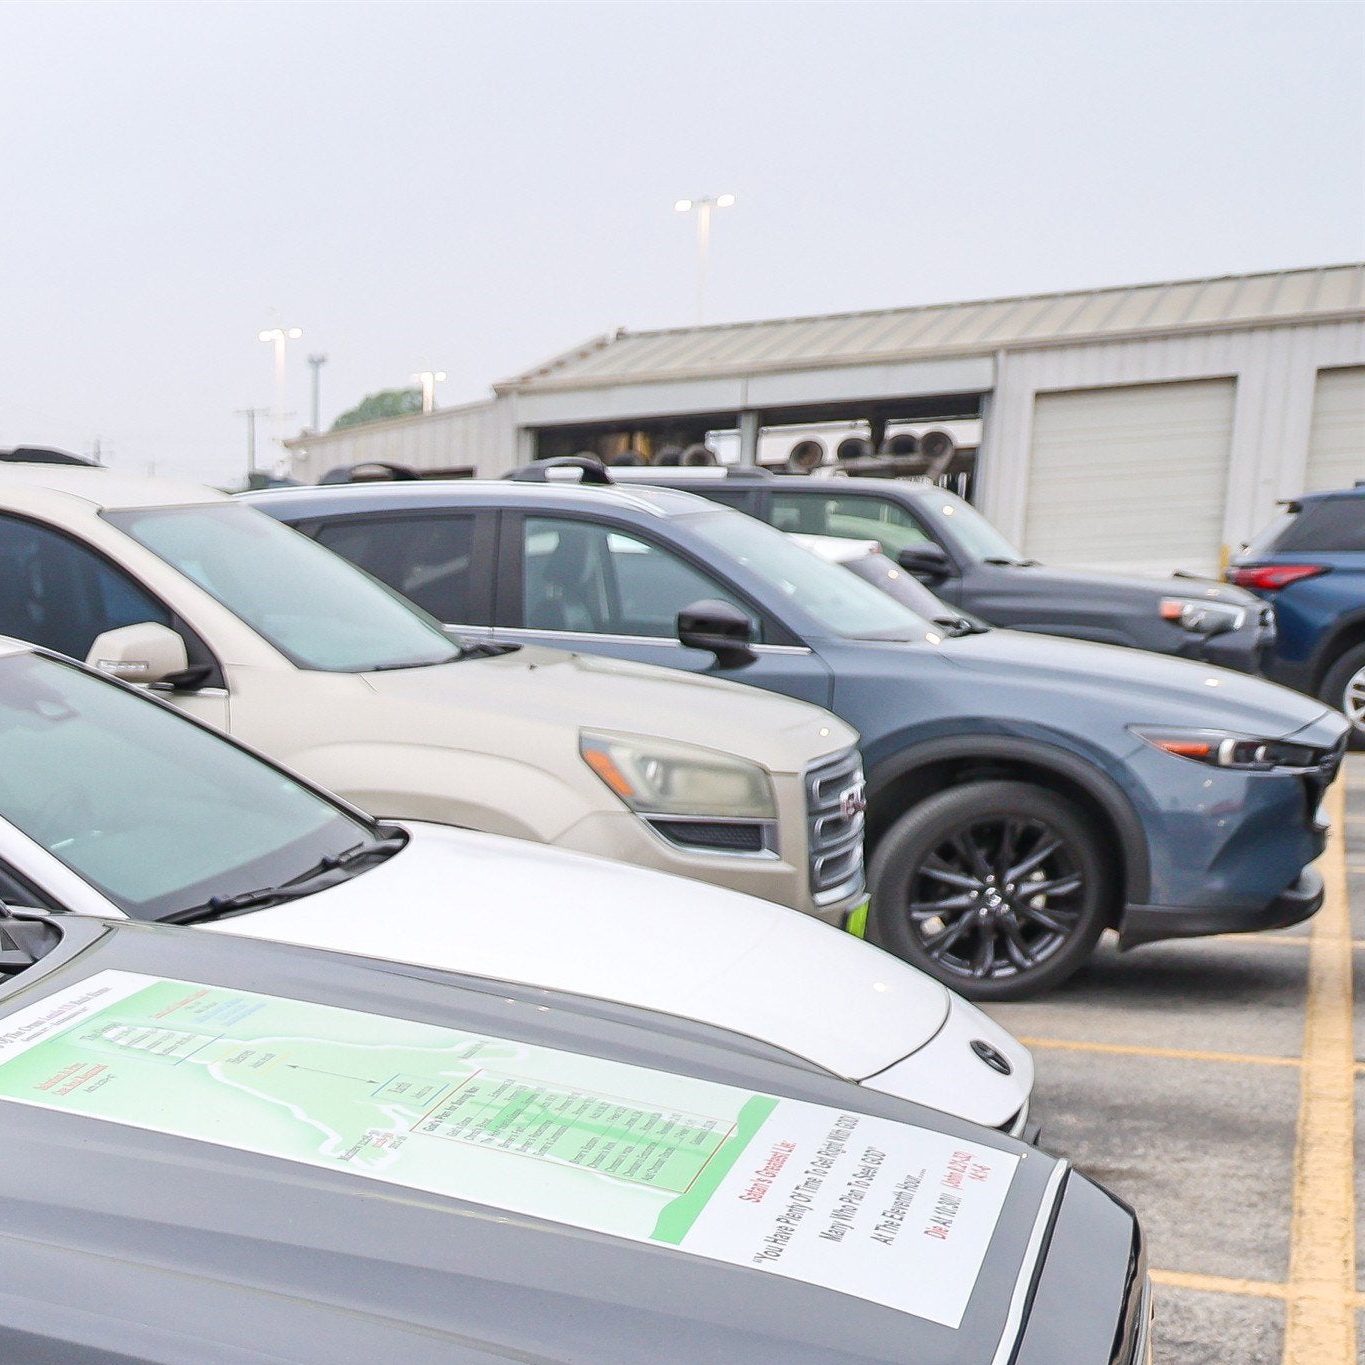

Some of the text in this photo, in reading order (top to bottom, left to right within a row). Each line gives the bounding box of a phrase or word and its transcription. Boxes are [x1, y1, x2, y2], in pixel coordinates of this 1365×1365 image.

[738, 1140, 797, 1203] Satan's Greatest Lie:
[941, 1171, 969, 1190] (John
[752, 1113, 859, 1263] "You Have Plenty Of Time To Get Right With GOD!
[818, 1146, 886, 1242] Many Who Plan To Seek GOD"
[881, 1191, 914, 1221] Eleventh
[873, 1220, 901, 1235] The
[929, 1215, 953, 1228] At
[870, 1232, 894, 1245] At
[923, 1225, 949, 1240] Die
